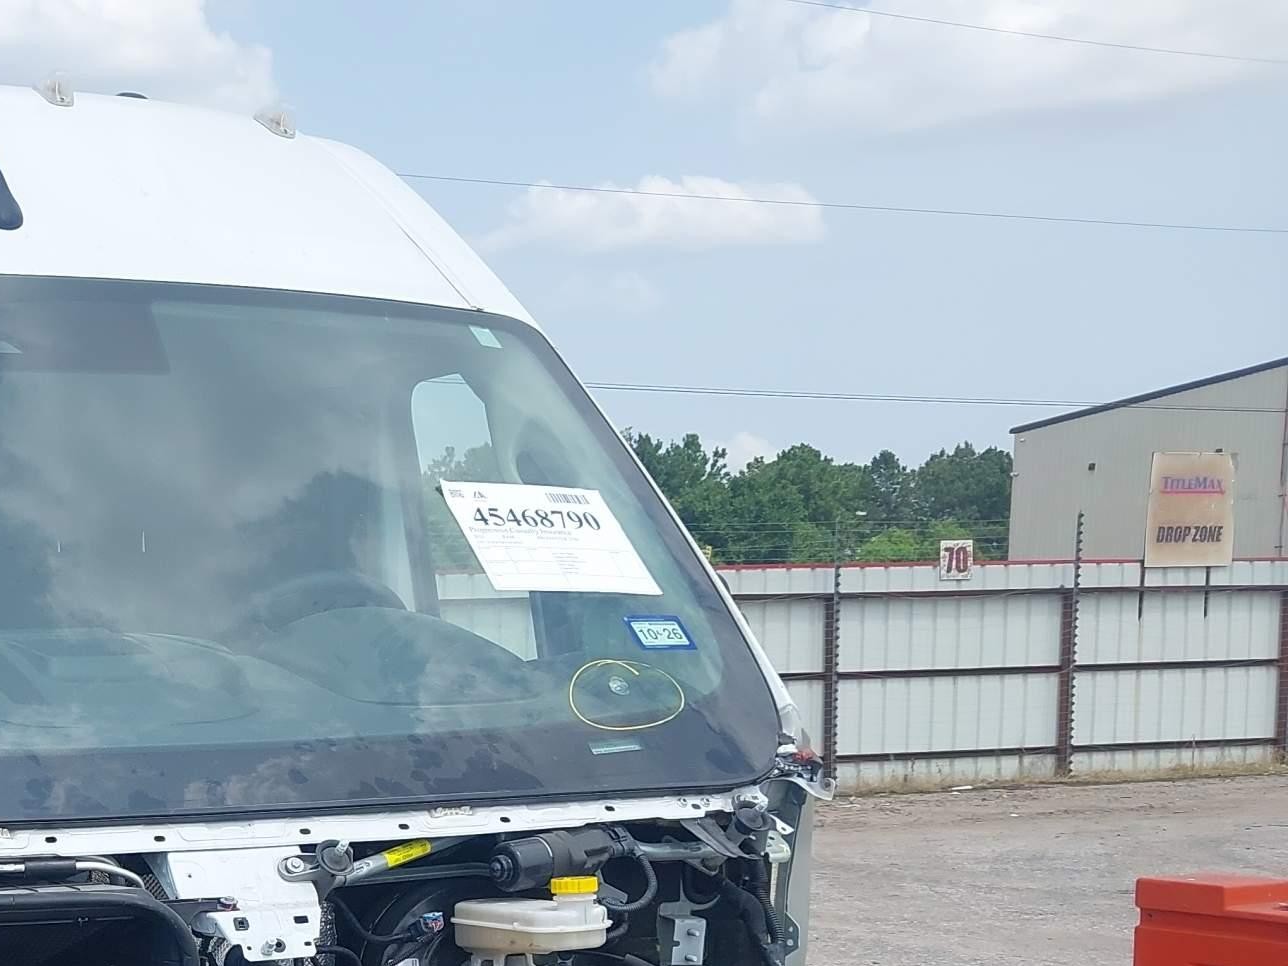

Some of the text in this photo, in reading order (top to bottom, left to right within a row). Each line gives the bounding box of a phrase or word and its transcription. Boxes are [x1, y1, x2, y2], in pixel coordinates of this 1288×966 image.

[473, 507, 601, 531] 45468790
[1156, 526, 1223, 543] DROP ZONE
[943, 546, 969, 573] 70
